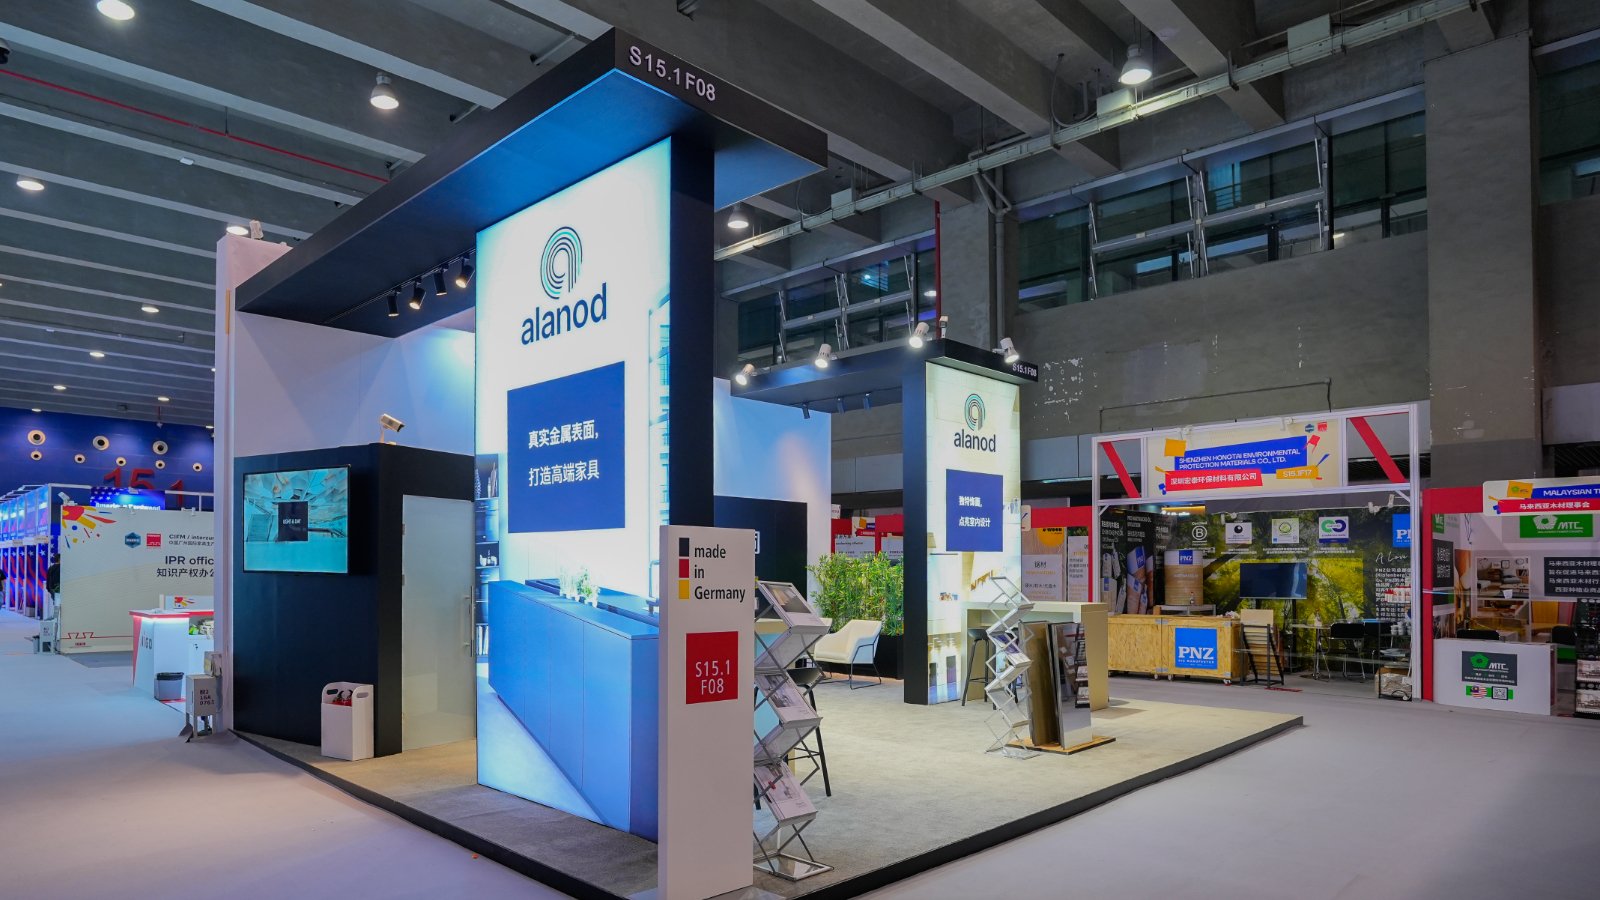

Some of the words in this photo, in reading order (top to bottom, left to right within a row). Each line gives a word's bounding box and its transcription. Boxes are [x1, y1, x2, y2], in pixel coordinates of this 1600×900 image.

[521, 283, 607, 345] alanod
[953, 429, 996, 452] alanod
[1179, 455, 1212, 464] SHENZHEN
[1213, 453, 1242, 461] HONGTAI
[1243, 449, 1301, 459] ENVIRONMENTAL
[1179, 461, 1219, 470] PROTECTION
[1220, 459, 1256, 467] MATERIALS
[528, 460, 600, 487] 打造高端家具
[1543, 488, 1592, 496] MALAYSIAN
[1519, 501, 1590, 510] 马来西亚木材理事会
[1557, 521, 1584, 530] MTC
[694, 544, 727, 559] made
[165, 555, 186, 565] IPR
[694, 564, 705, 579] in
[694, 585, 746, 603] Germany
[1178, 646, 1214, 660] PNZ
[695, 659, 731, 678] S15.1
[1488, 662, 1509, 670] MTC
[701, 677, 725, 695] F08
